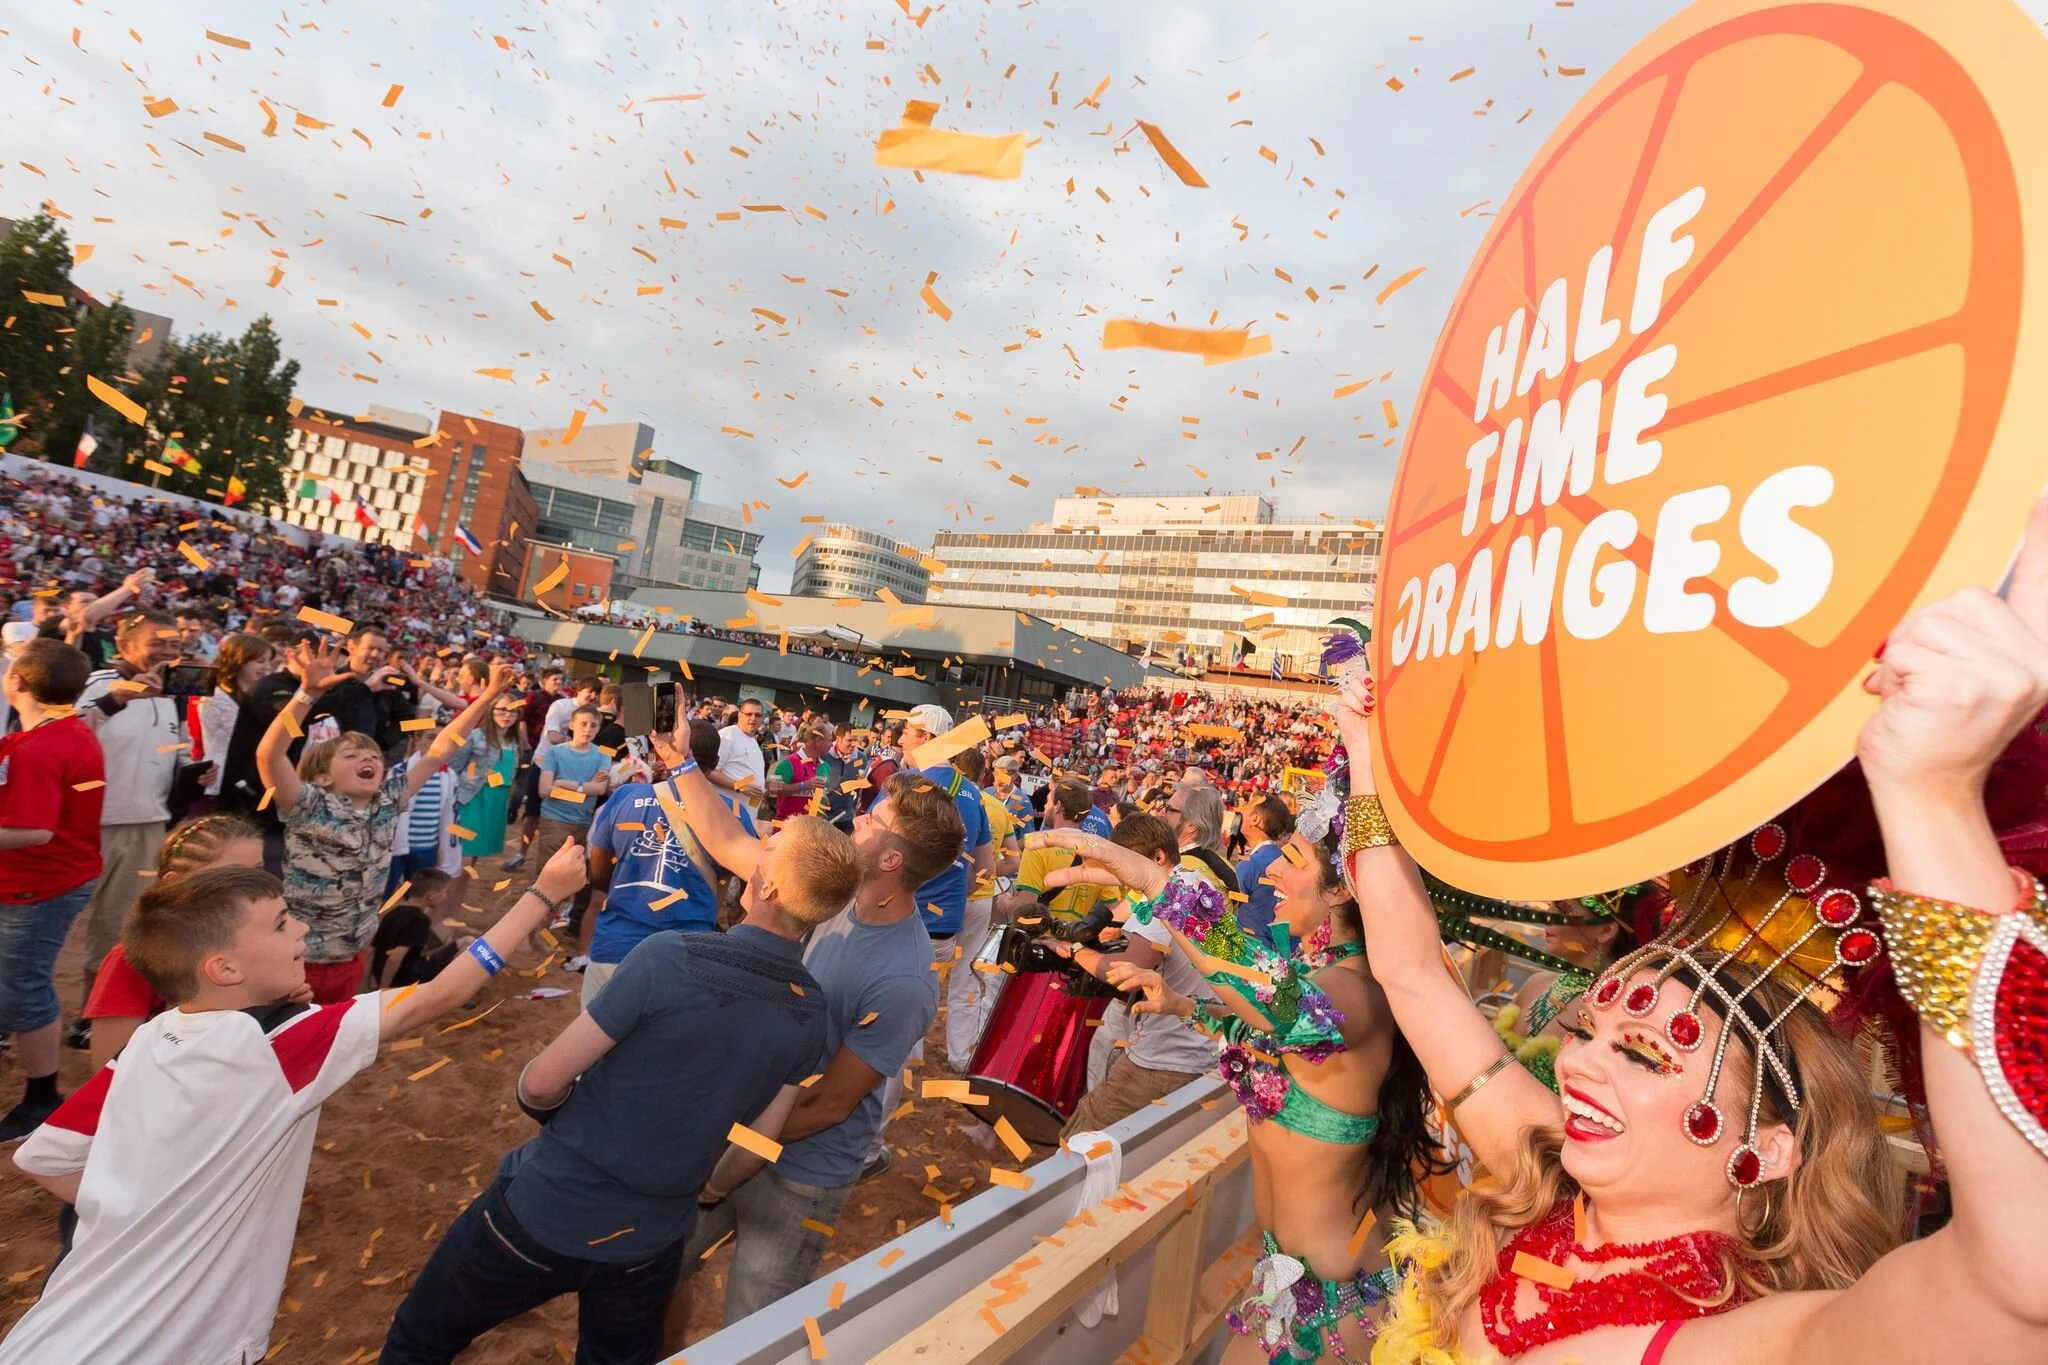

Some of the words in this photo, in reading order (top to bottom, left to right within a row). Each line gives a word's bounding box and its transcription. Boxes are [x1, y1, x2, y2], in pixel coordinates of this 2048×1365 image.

[1474, 186, 1706, 423] HALF
[1461, 344, 1678, 536] TIME
[1391, 464, 1834, 667] ORANGES
